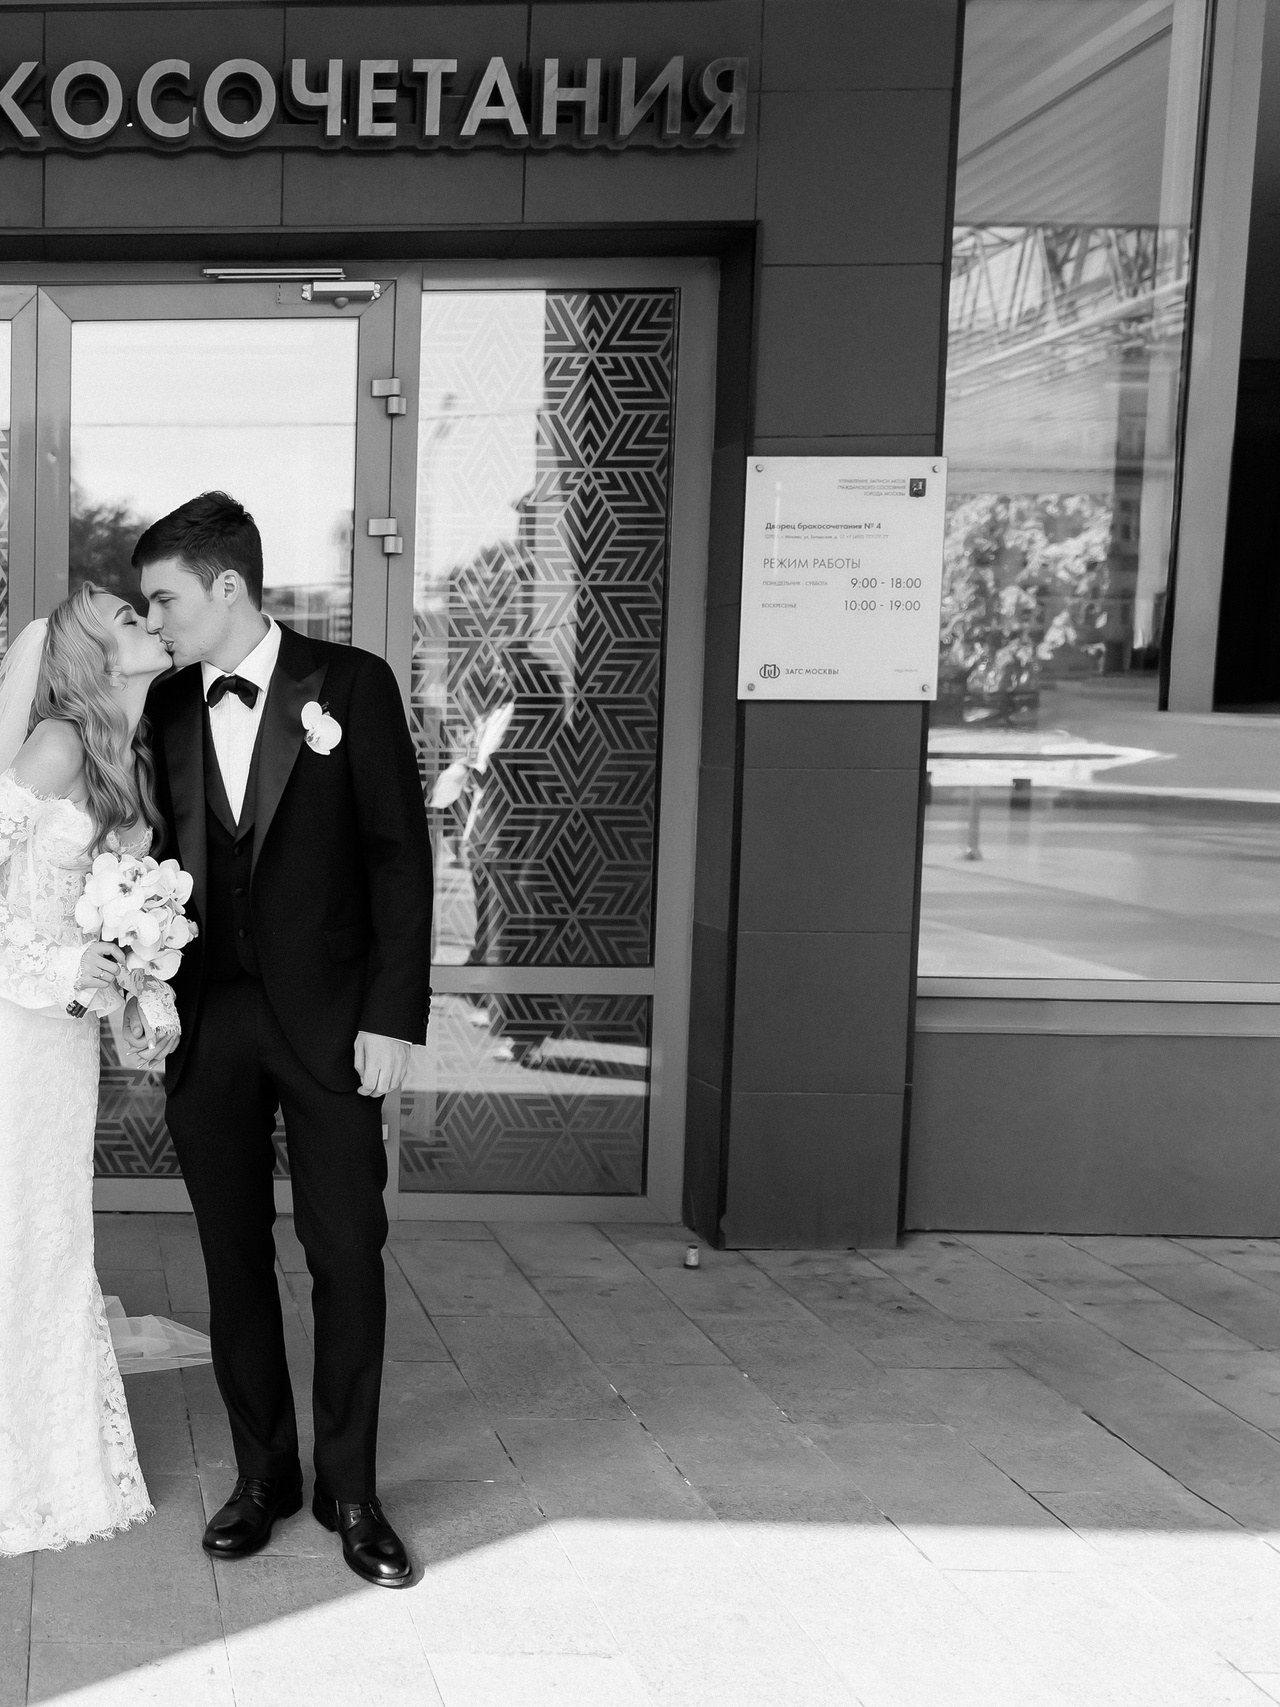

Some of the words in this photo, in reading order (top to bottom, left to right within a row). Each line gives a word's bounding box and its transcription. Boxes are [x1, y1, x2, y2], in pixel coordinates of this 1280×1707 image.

[765, 522, 796, 531] Дворец
[797, 522, 862, 531] бракосочетания
[763, 558, 809, 569] РЕЖИМ
[812, 558, 861, 569] РАБОТЫ
[850, 577, 878, 589] 9:00
[890, 577, 922, 589] 18:00
[844, 600, 877, 611] 10:00
[889, 600, 921, 611] 19:00
